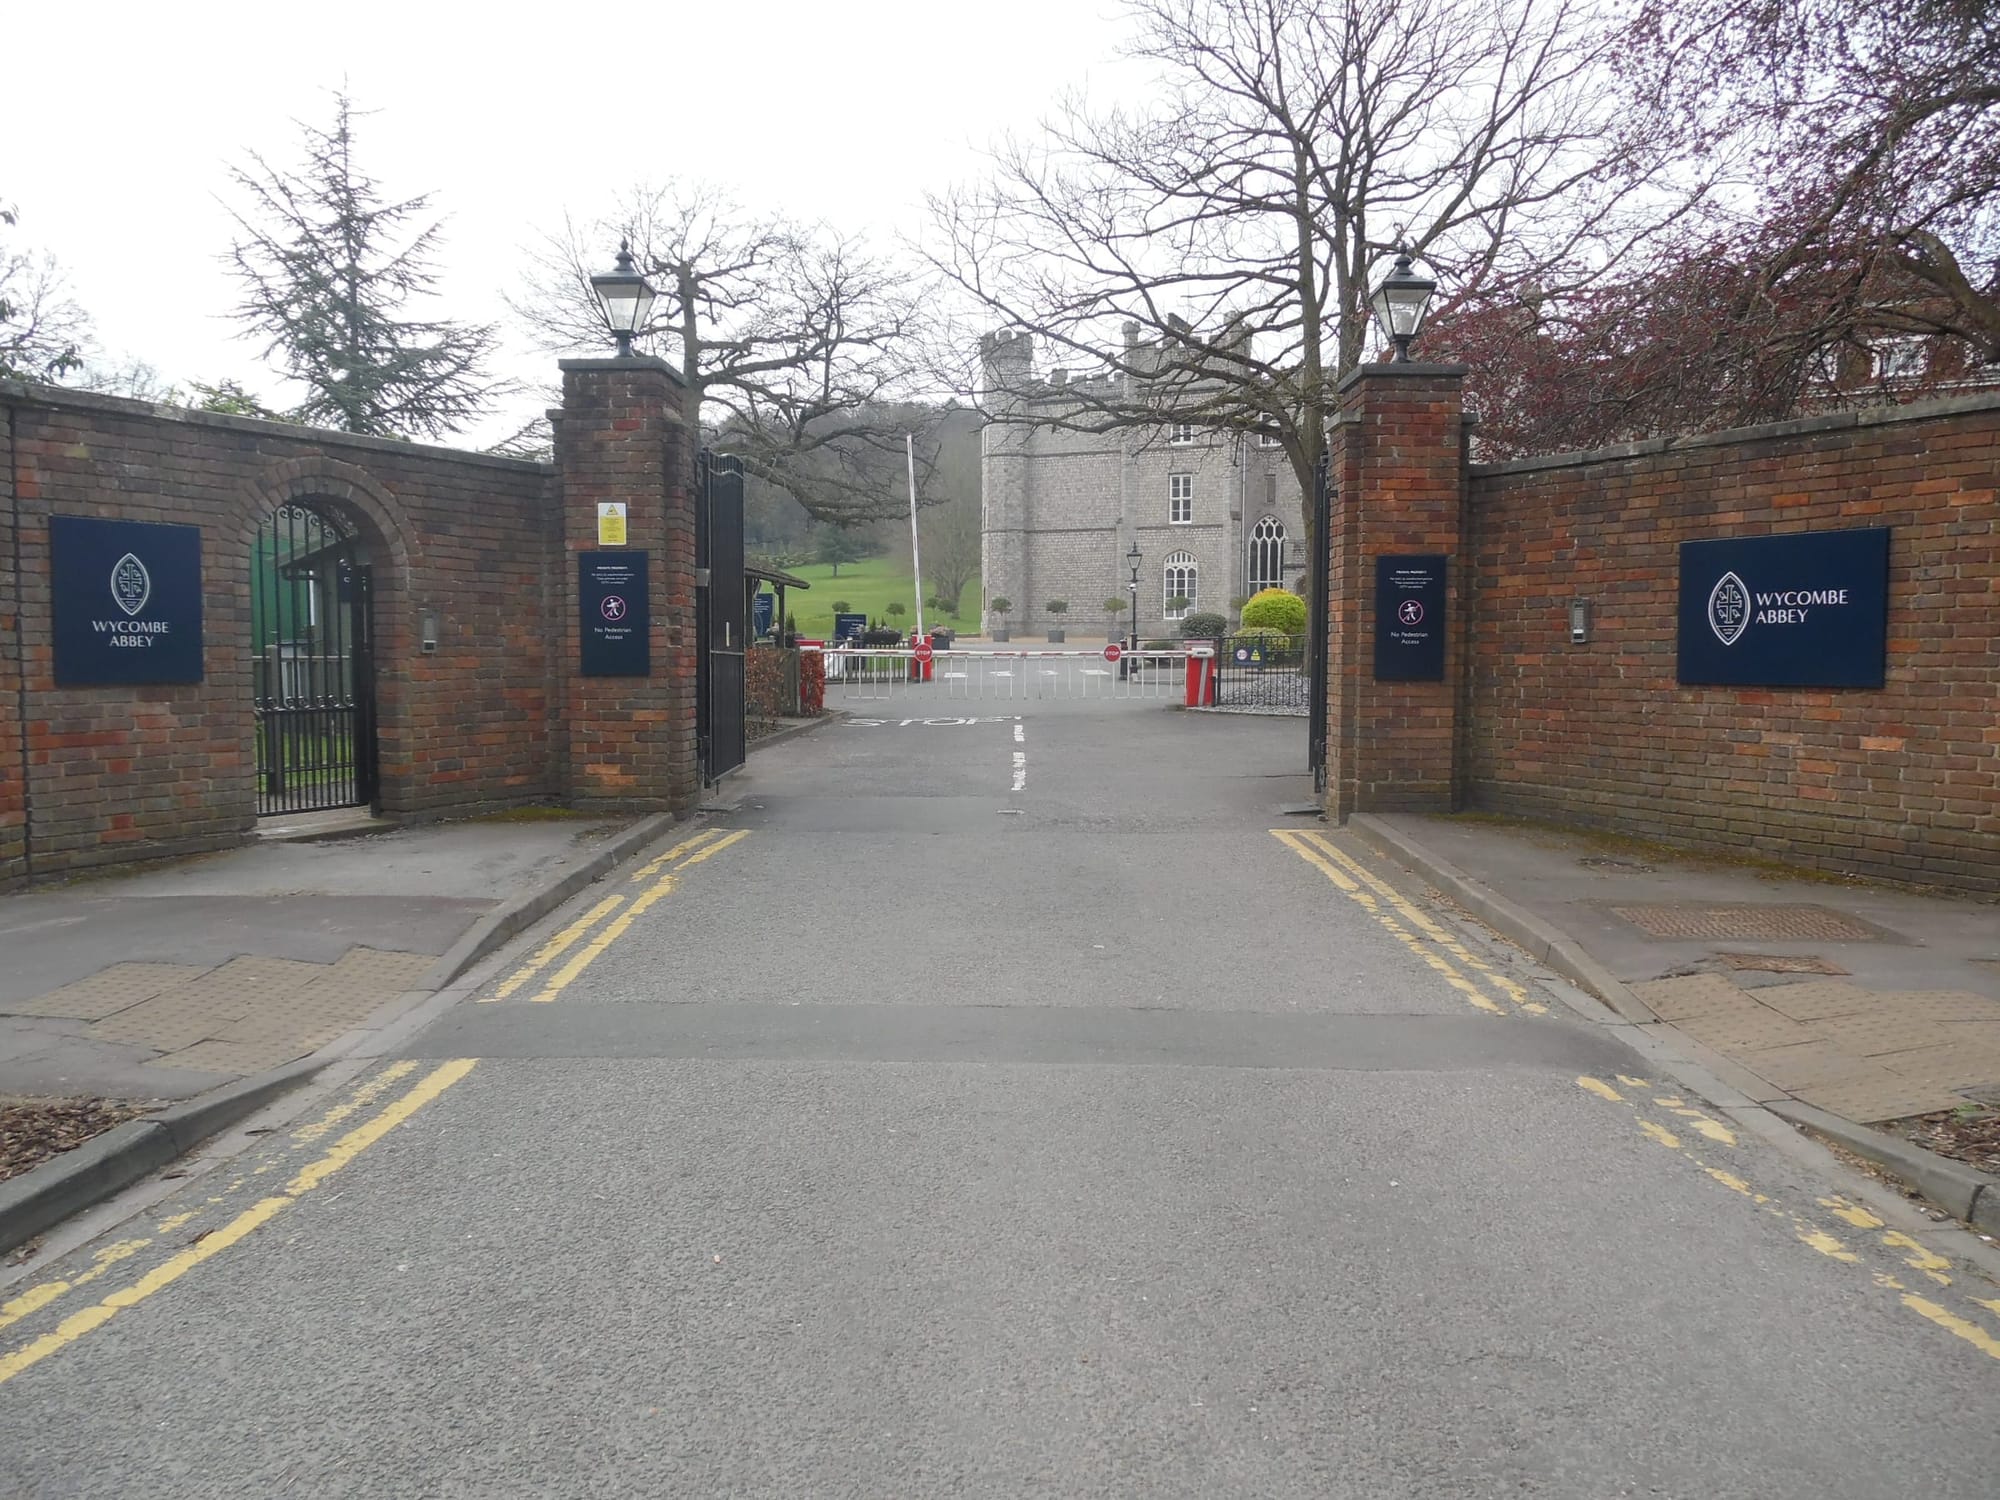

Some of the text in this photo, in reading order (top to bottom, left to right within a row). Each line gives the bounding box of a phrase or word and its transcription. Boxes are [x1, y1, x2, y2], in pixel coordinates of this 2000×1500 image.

[1756, 589, 1849, 606] WYCOMBE
[1755, 609, 1809, 624] ABBEY
[92, 620, 169, 633] WYCOMBE
[109, 635, 154, 647] ABBEY
[841, 716, 1013, 726] STOP
